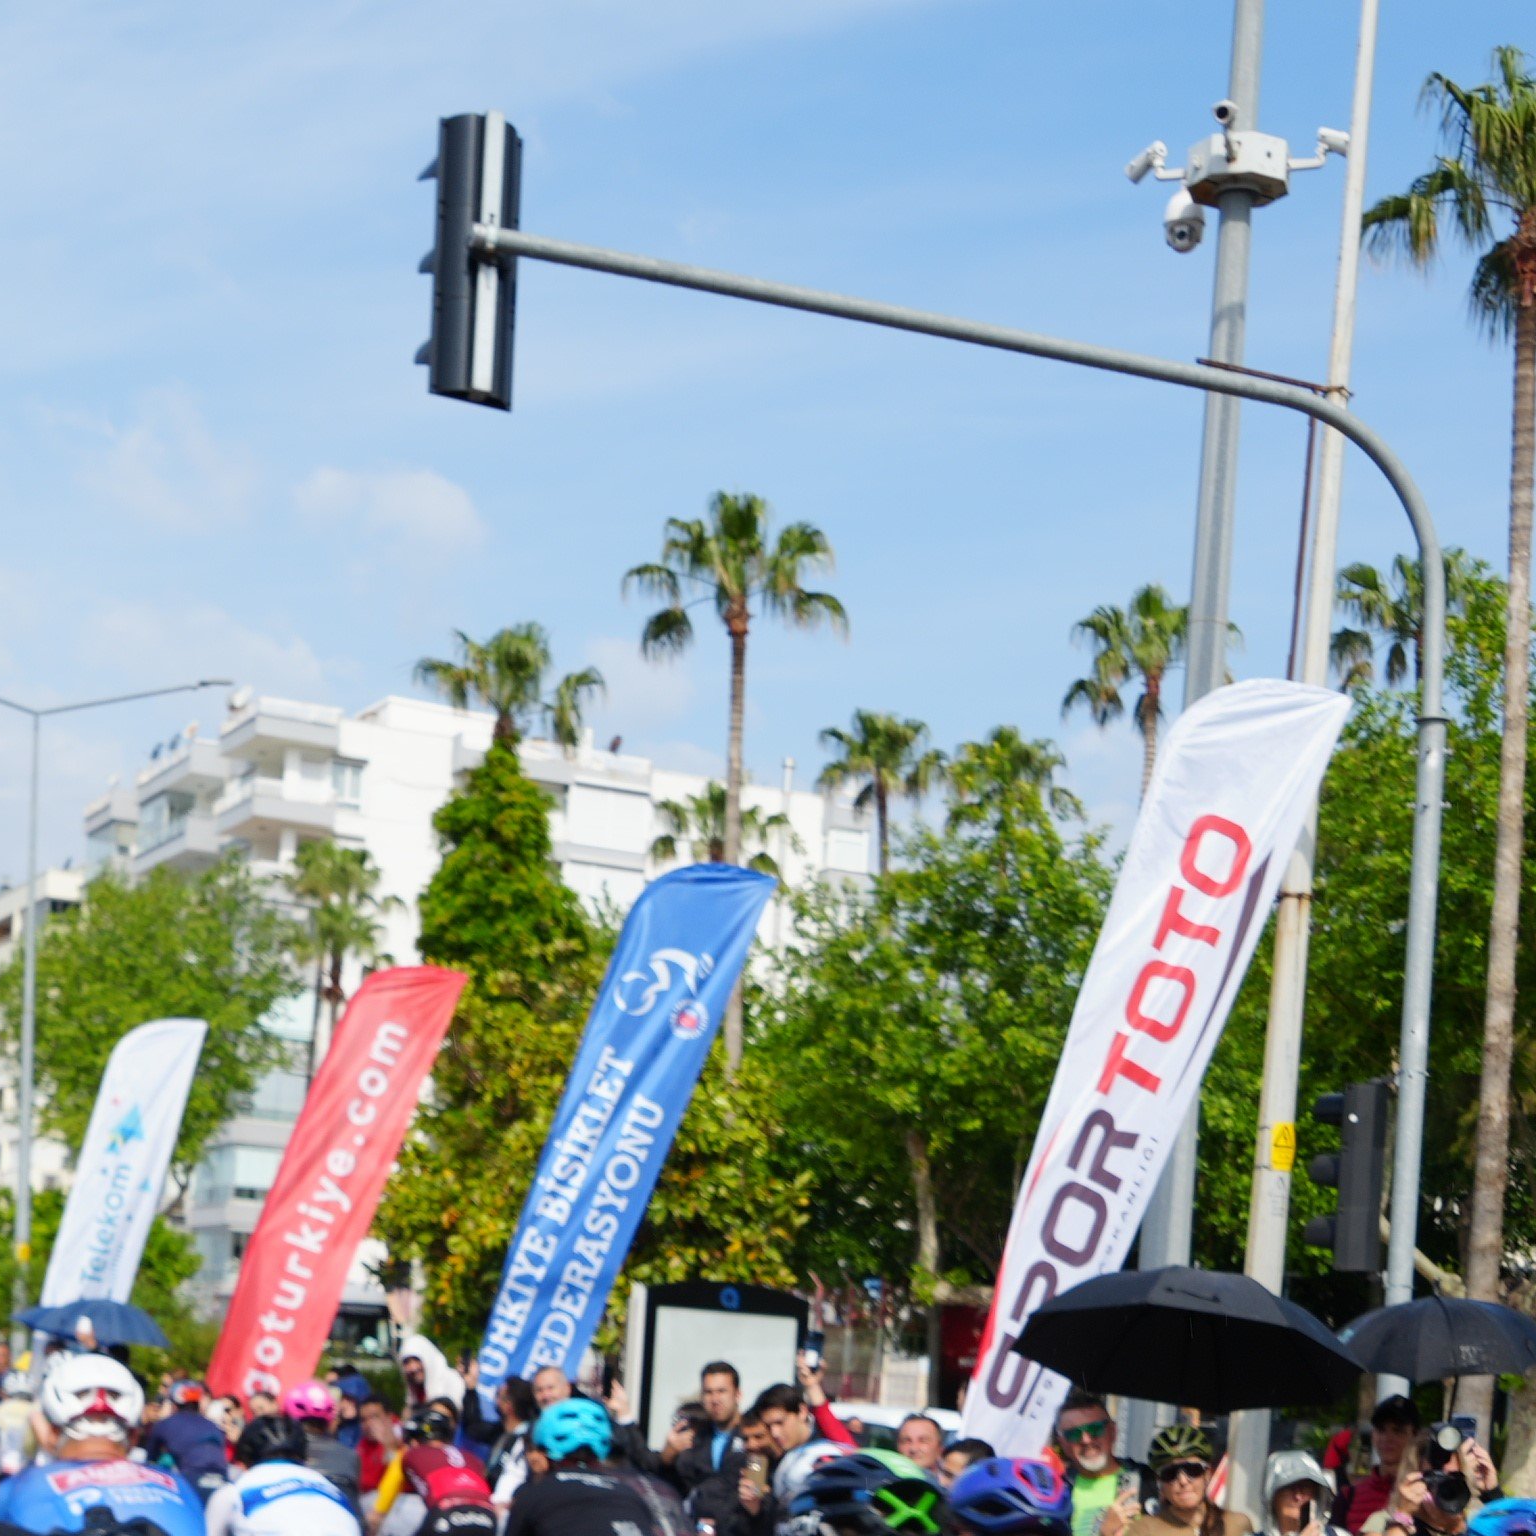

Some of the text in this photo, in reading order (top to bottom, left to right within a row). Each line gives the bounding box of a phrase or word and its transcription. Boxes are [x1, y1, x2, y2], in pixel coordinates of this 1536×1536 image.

[1096, 812, 1251, 1096] TOTO
[80, 1163, 133, 1285] Telekom
[539, 1047, 634, 1226] BİSİKLET
